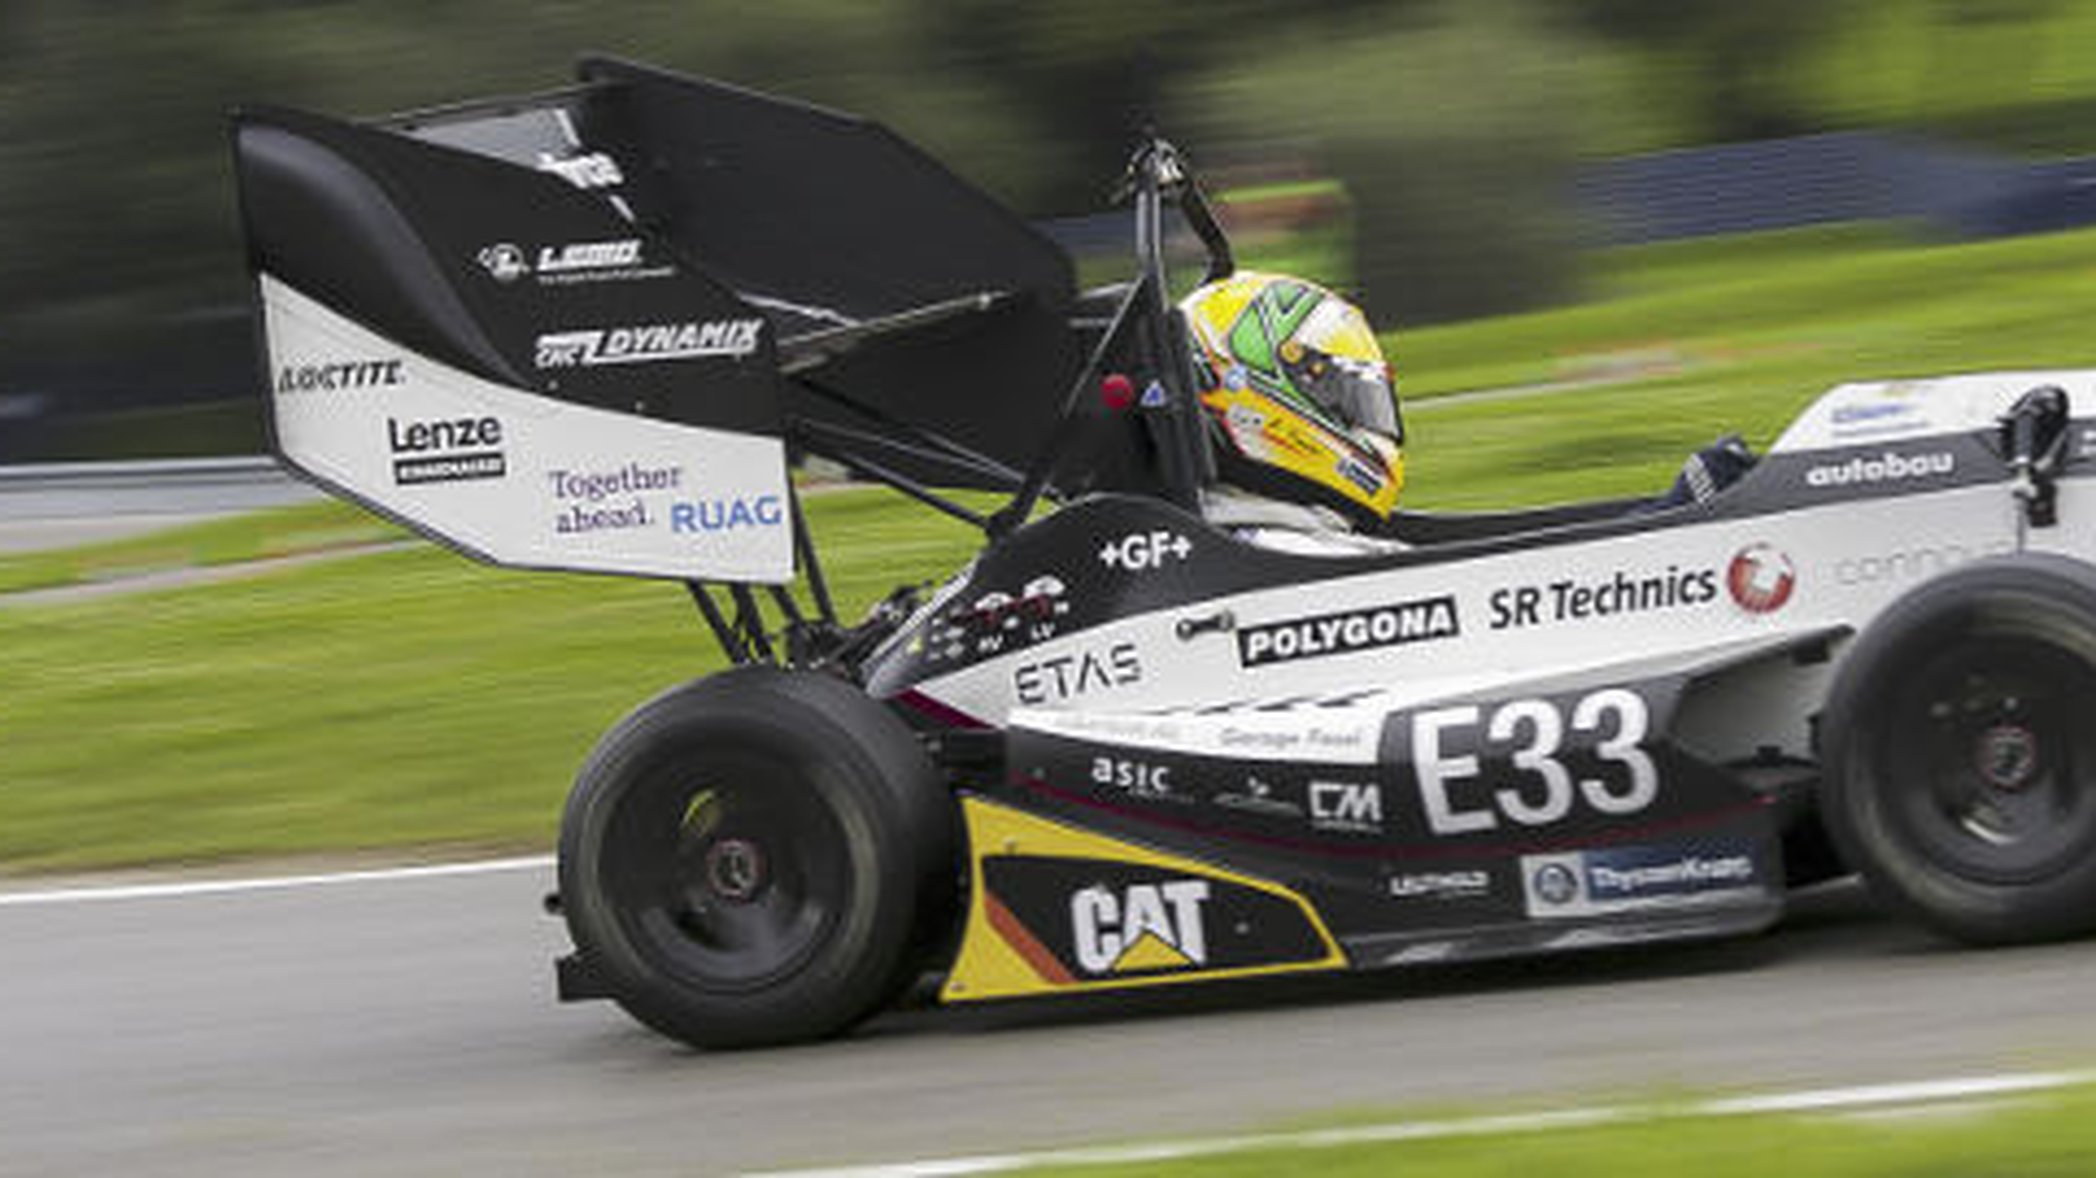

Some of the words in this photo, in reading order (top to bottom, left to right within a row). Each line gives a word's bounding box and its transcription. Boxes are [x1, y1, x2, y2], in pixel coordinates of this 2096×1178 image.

[603, 318, 765, 354] DYNAMIX
[388, 416, 501, 453] Lenze
[549, 461, 683, 501] Together
[1805, 453, 1954, 486] autobau
[670, 496, 783, 533] RUAG
[1489, 585, 1542, 630] SR
[1549, 566, 1717, 621] Technics
[1246, 604, 1453, 661] POLYGONA
[1014, 642, 1141, 705] ETAS
[1410, 687, 1660, 837] E33
[1070, 880, 1210, 973] CAT
